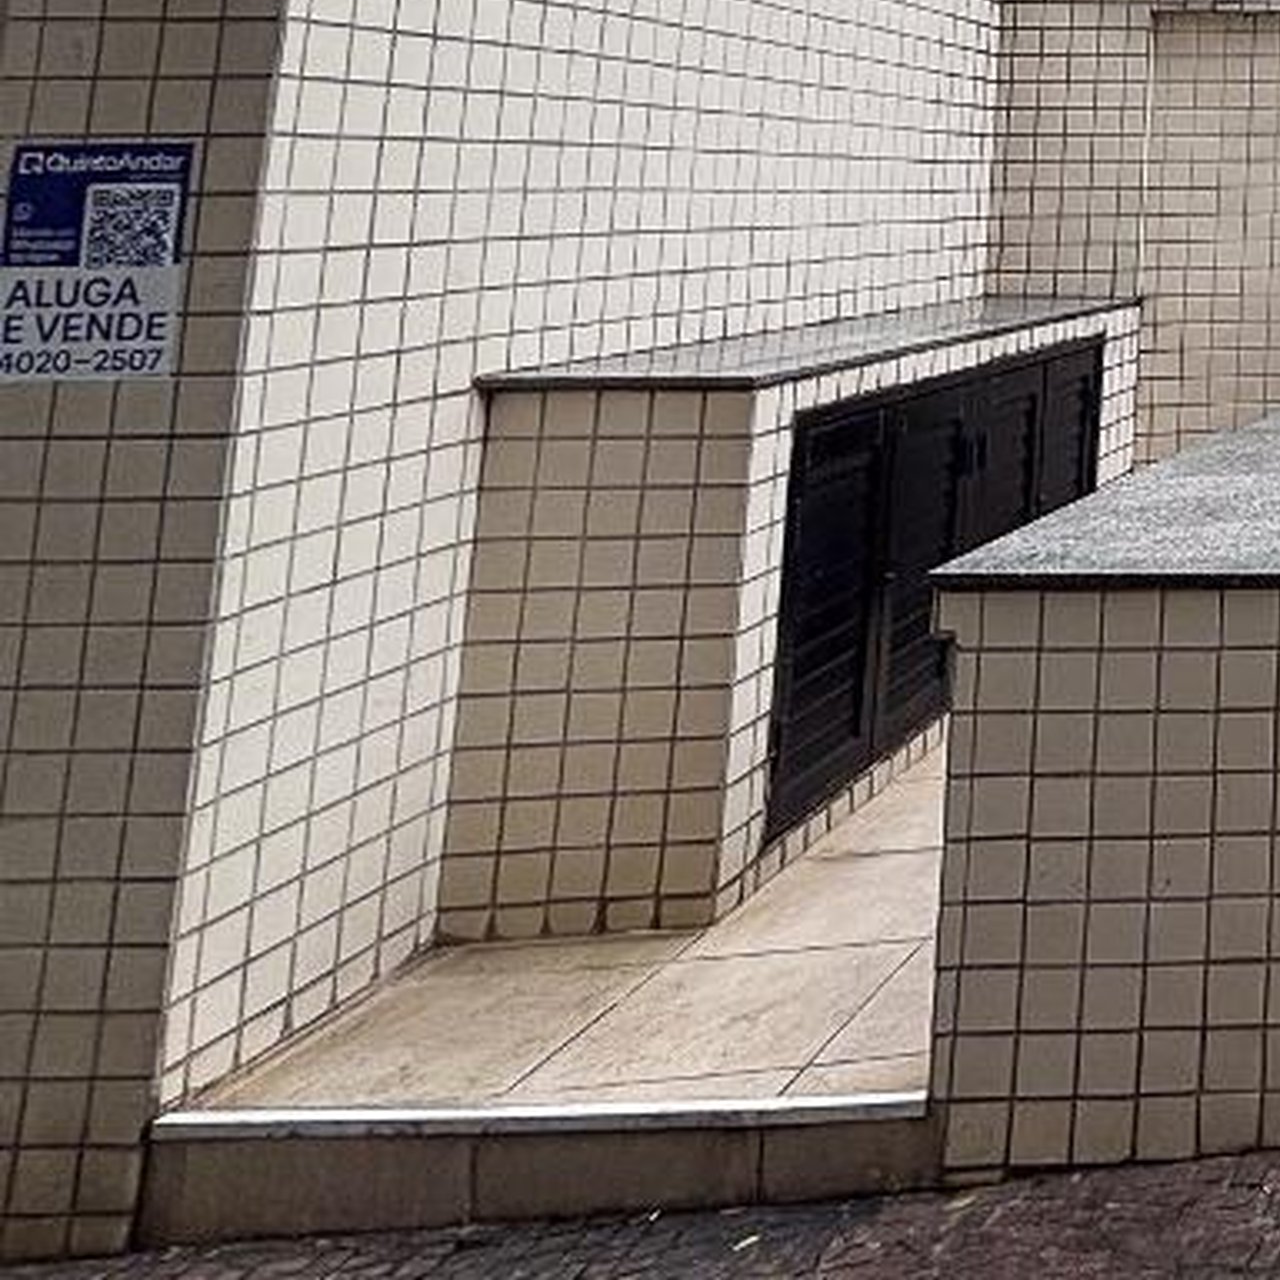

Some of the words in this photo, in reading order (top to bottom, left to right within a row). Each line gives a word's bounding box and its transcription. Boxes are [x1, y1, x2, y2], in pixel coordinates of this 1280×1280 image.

[46, 151, 187, 171] QuintoAndar
[4, 276, 141, 309] ALUGA
[3, 314, 24, 344] E
[35, 311, 169, 343] VENDE
